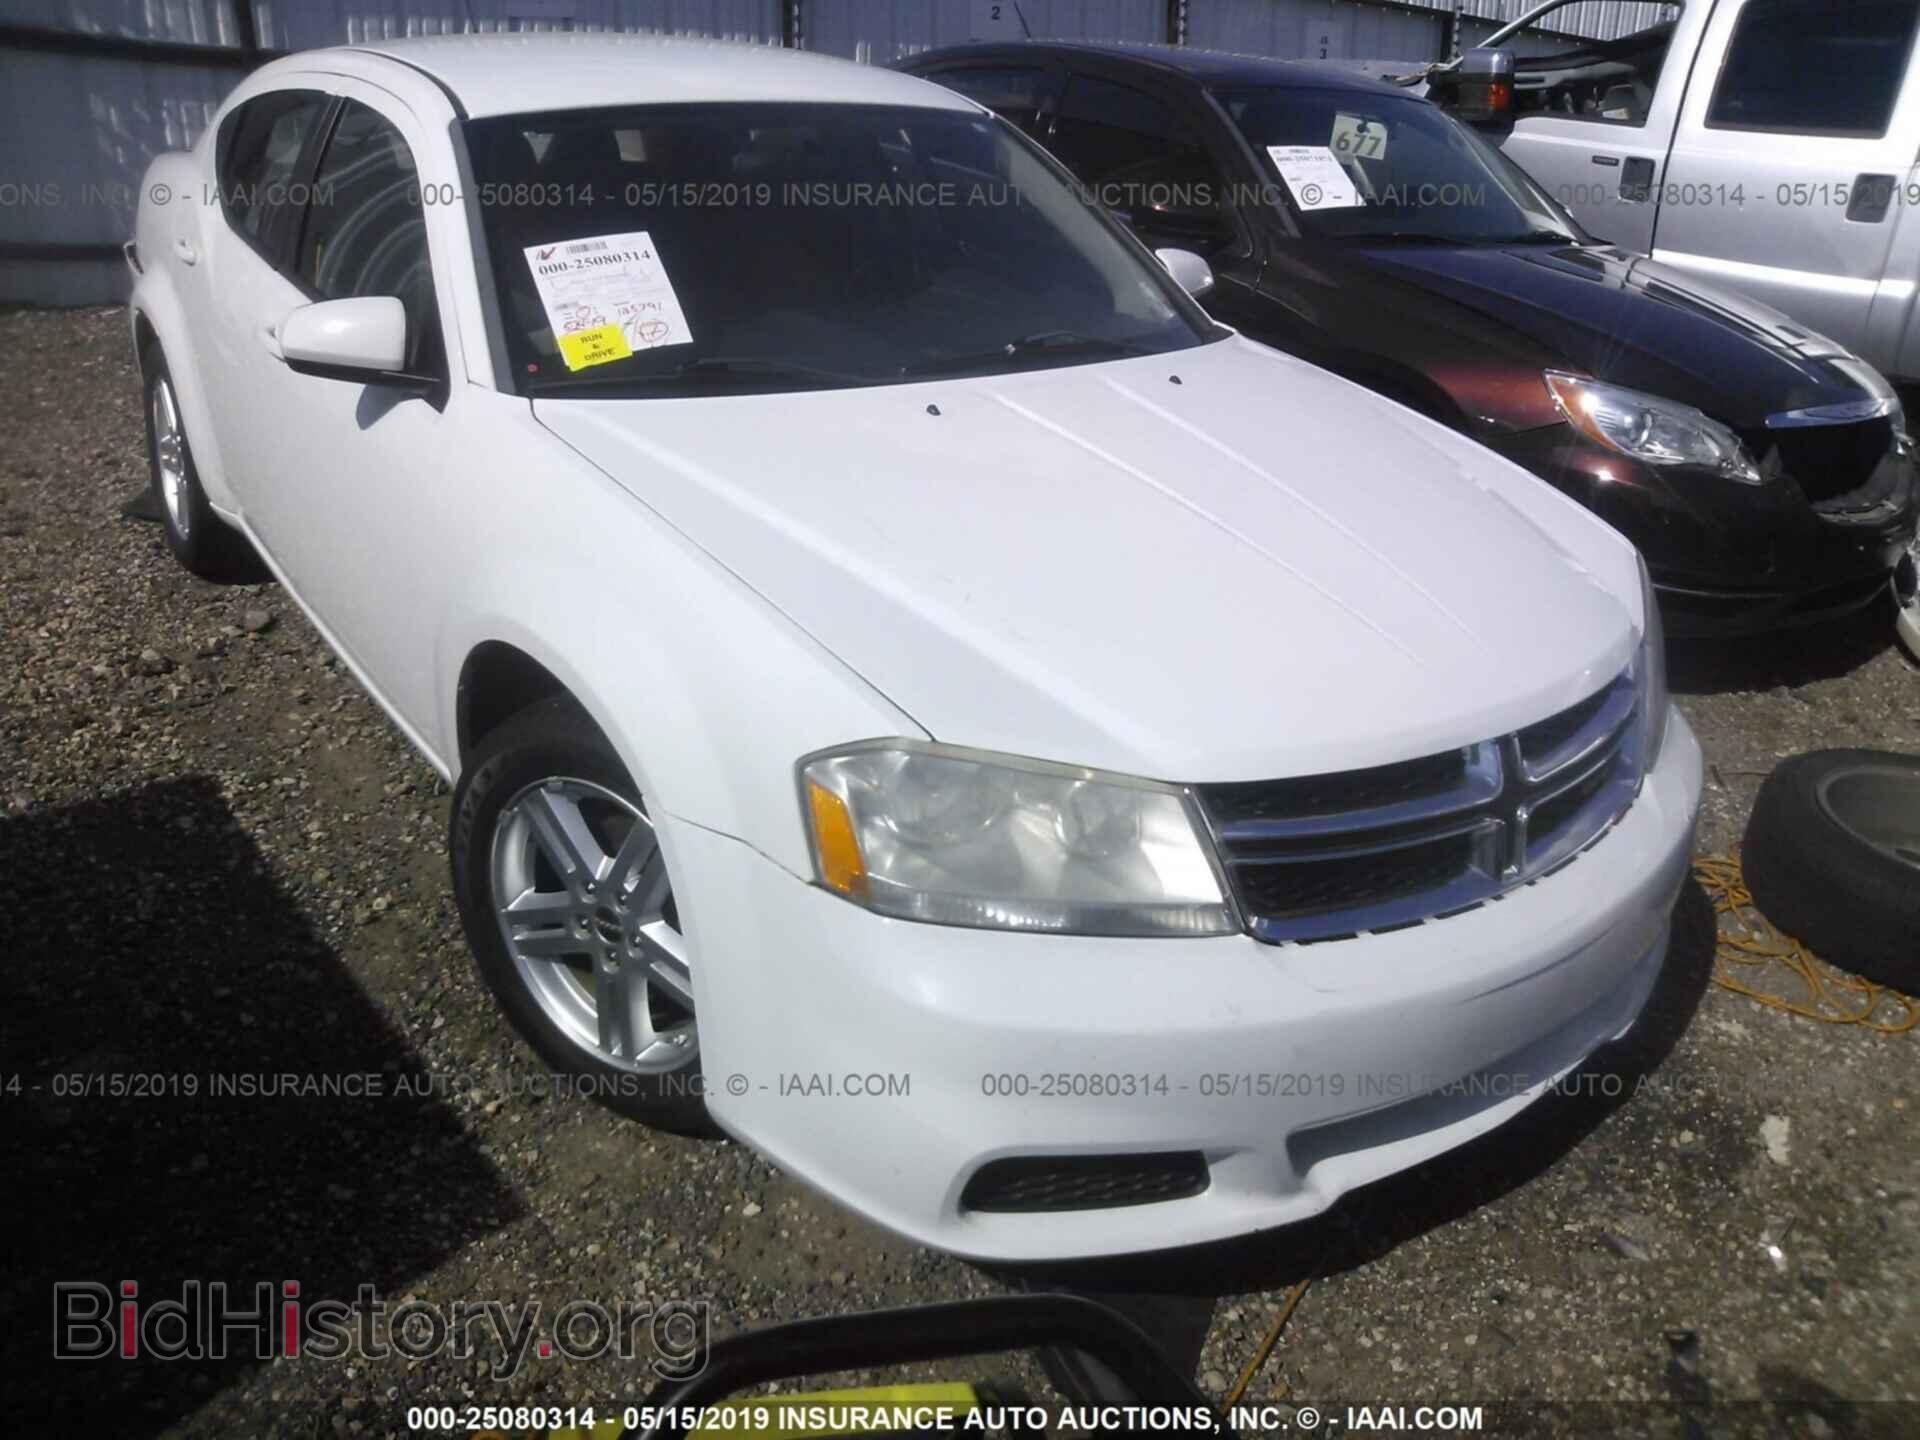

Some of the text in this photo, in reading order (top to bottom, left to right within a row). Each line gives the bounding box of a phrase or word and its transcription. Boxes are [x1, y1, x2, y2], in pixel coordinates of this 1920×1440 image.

[991, 5, 1001, 20] 2
[1335, 132, 1382, 156] 677
[538, 249, 651, 276] 000-25080314
[580, 332, 603, 344] RUN
[584, 347, 615, 361] DRIVE
